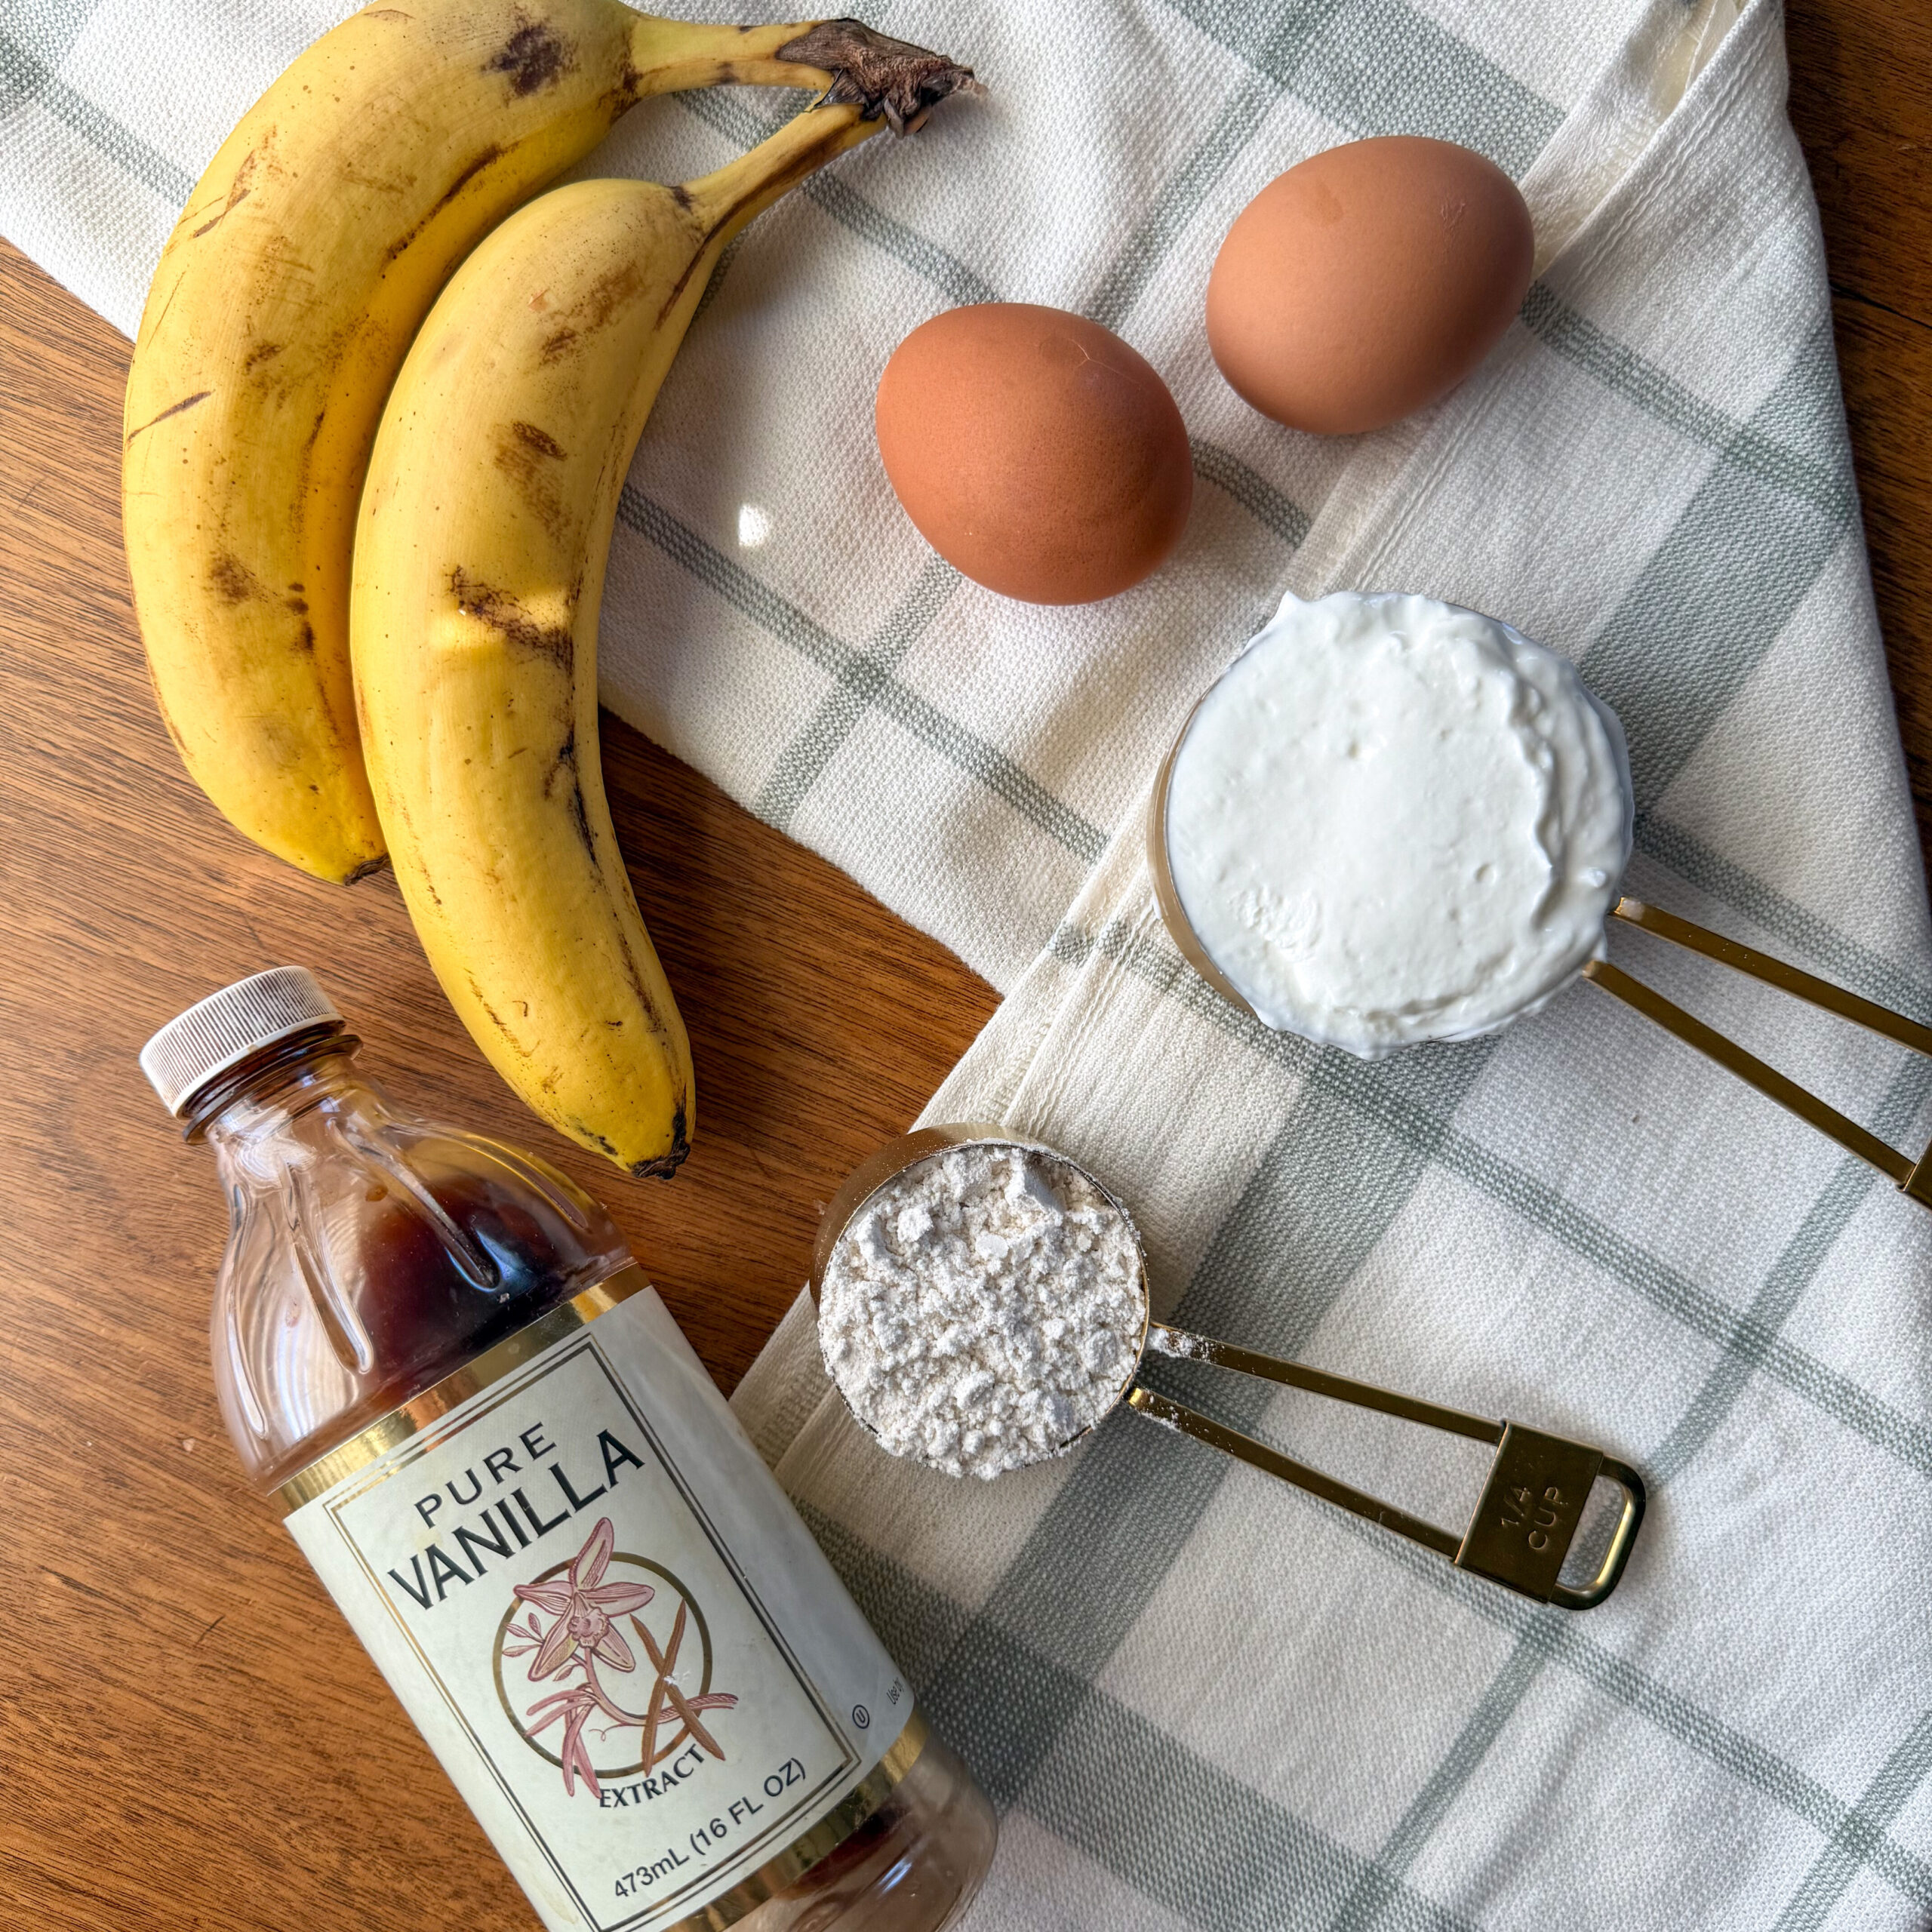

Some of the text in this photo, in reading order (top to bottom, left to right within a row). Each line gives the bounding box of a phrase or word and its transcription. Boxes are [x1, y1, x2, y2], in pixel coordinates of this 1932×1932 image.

[414, 1422, 556, 1529] PURE
[1500, 1487, 1531, 1527] 1/4
[1528, 1486, 1568, 1550] CUP
[387, 1429, 645, 1610] VANILLA
[599, 1743, 705, 1807] EXTRACT
[614, 1757, 807, 1899] 473mL (16 FL OZ)
